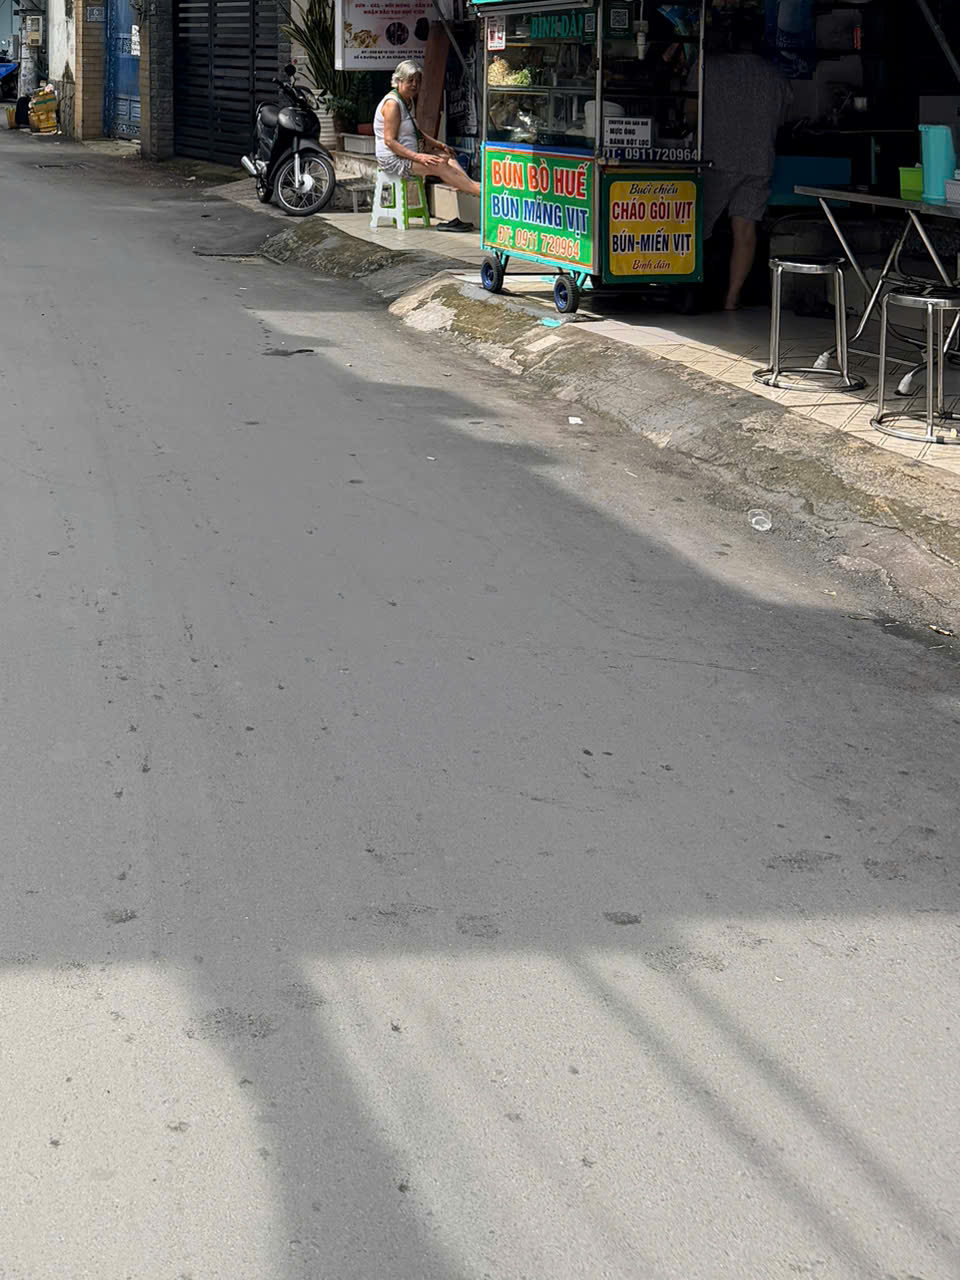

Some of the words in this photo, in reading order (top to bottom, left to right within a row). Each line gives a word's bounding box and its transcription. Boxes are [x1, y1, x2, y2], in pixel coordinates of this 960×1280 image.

[491, 155, 524, 190] BÚN
[527, 159, 551, 193] BÒ
[553, 161, 590, 199] HUẾ
[491, 190, 520, 220] BÚN
[522, 196, 563, 229] MĂNG
[565, 204, 589, 238] VỊT
[612, 197, 646, 220] CHÁO
[673, 201, 693, 224] VỊT
[515, 228, 538, 250] 0911
[541, 233, 581, 259] 720964
[673, 233, 692, 257] VỊT
